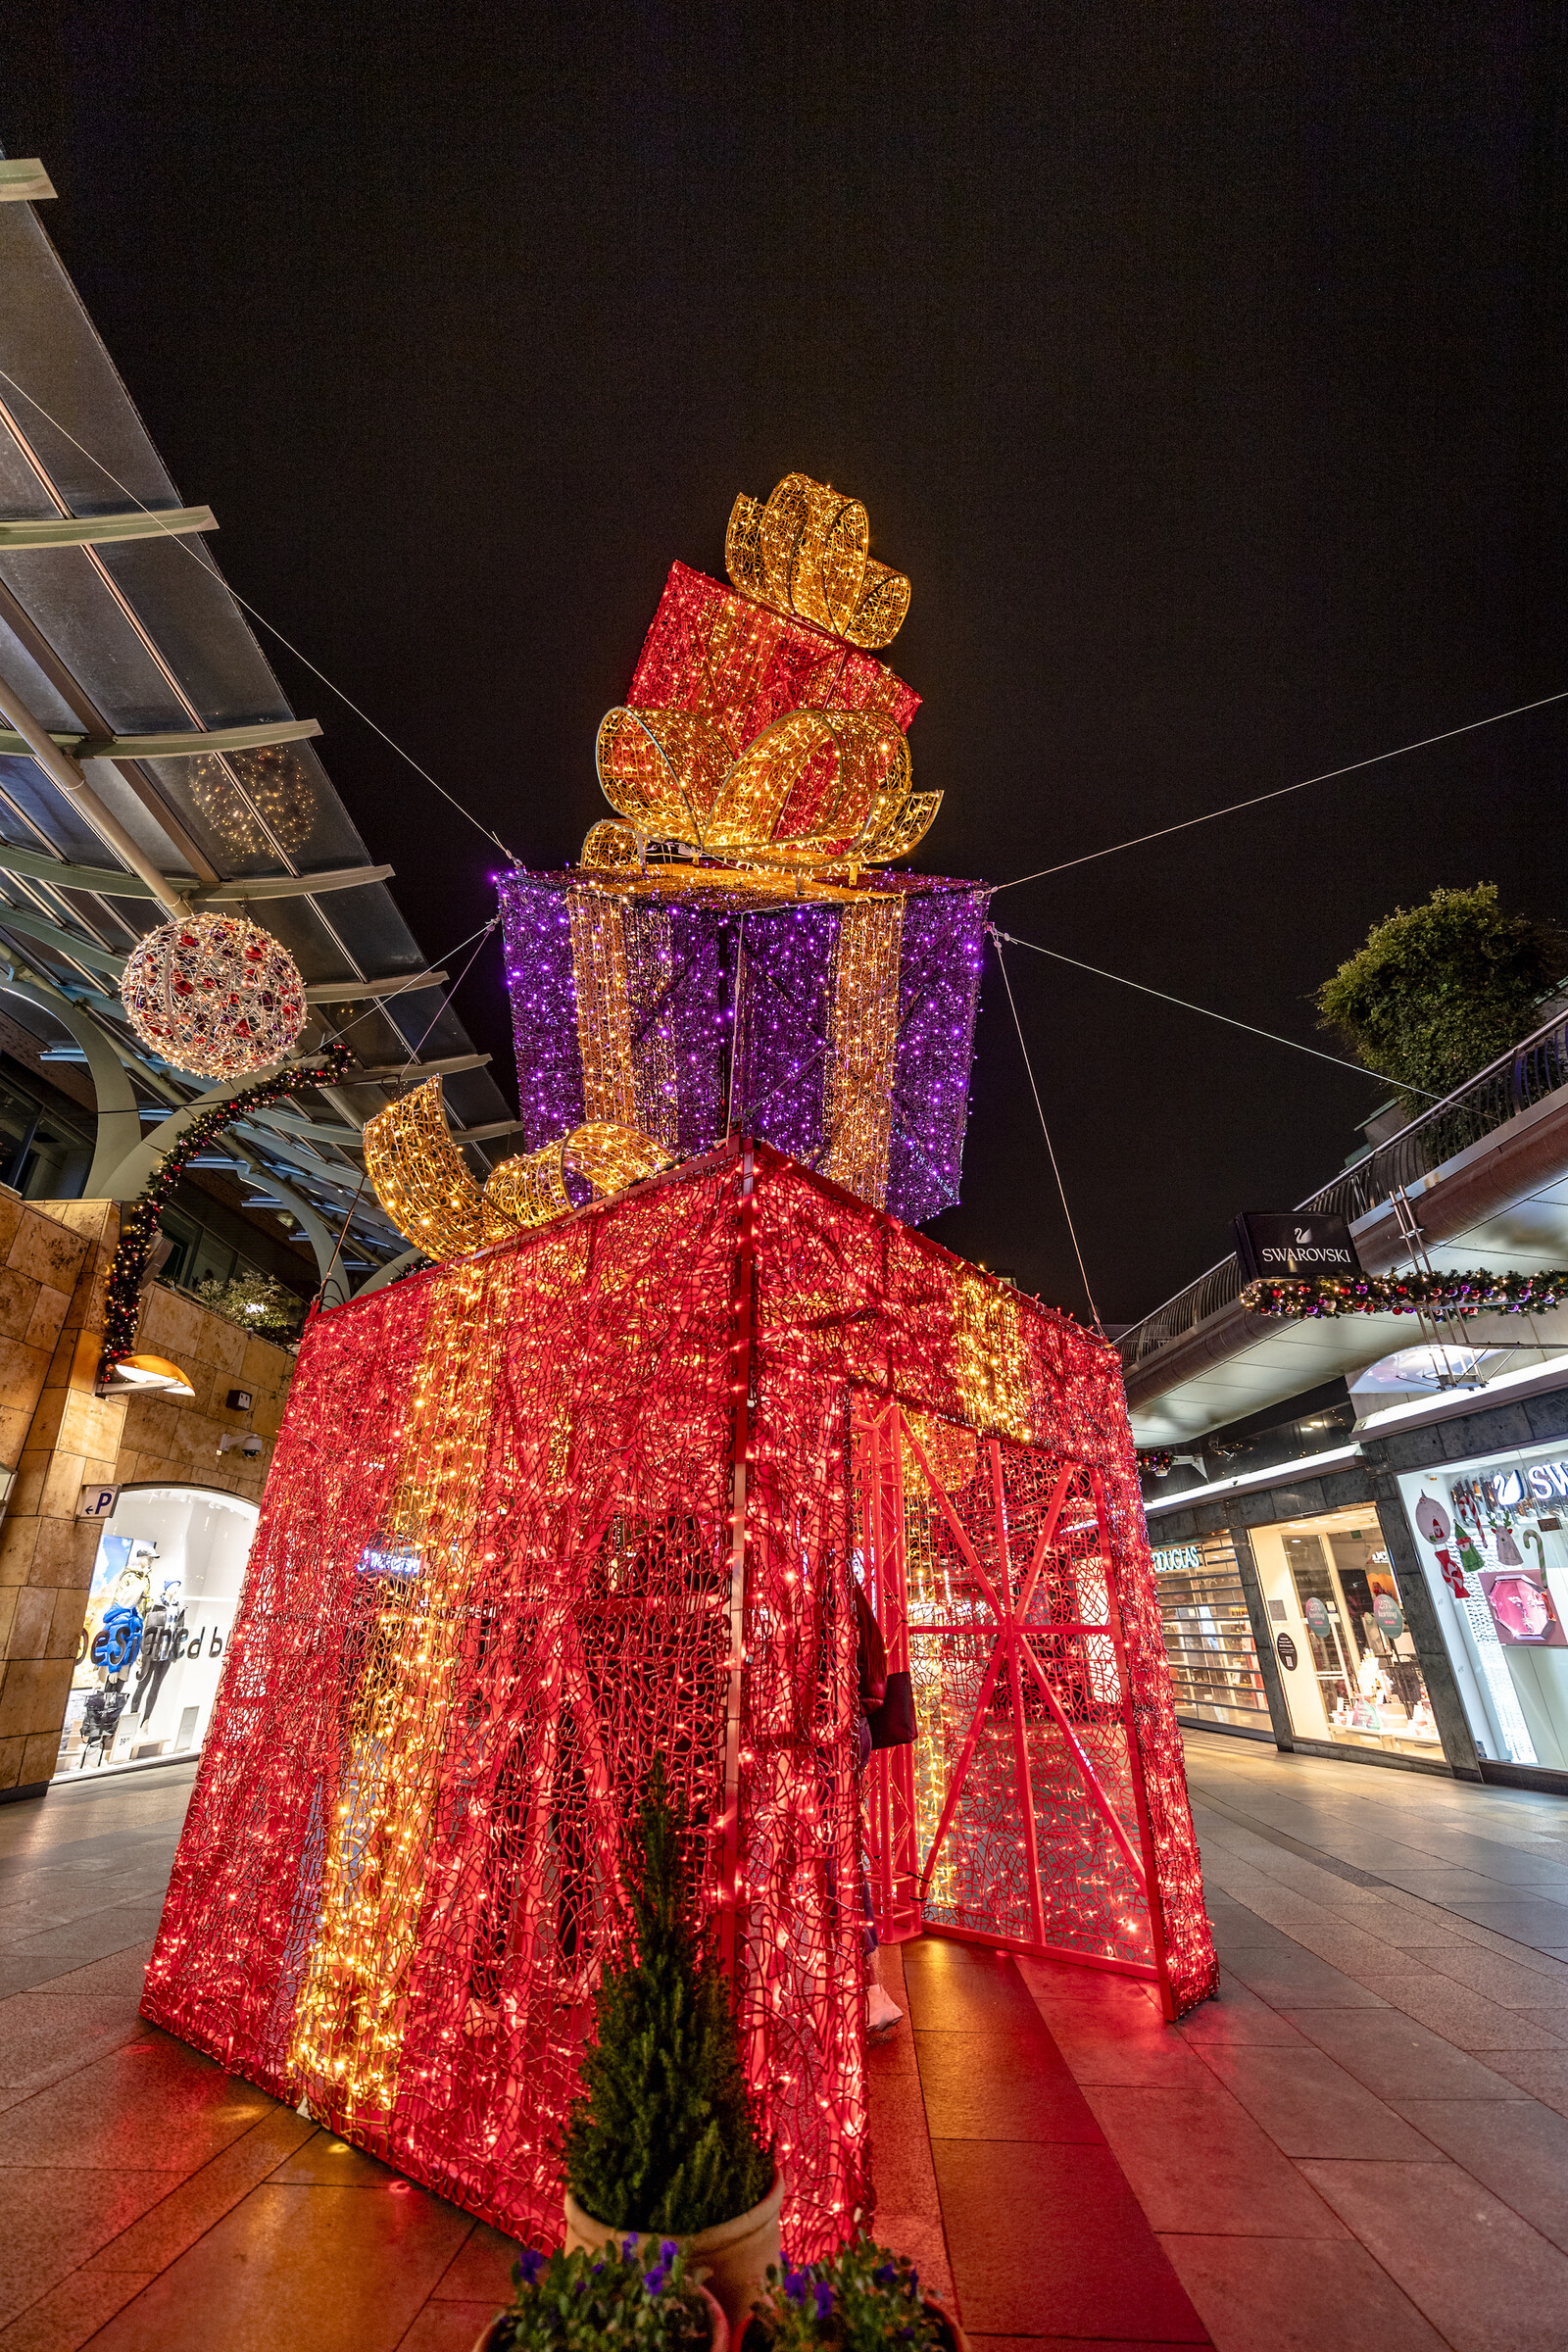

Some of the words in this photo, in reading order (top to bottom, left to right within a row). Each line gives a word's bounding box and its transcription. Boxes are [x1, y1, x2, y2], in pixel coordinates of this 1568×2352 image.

[1261, 1248, 1351, 1263] SWAROVSKI
[94, 1493, 113, 1514] P
[1152, 1545, 1200, 1572] DOUGLAS
